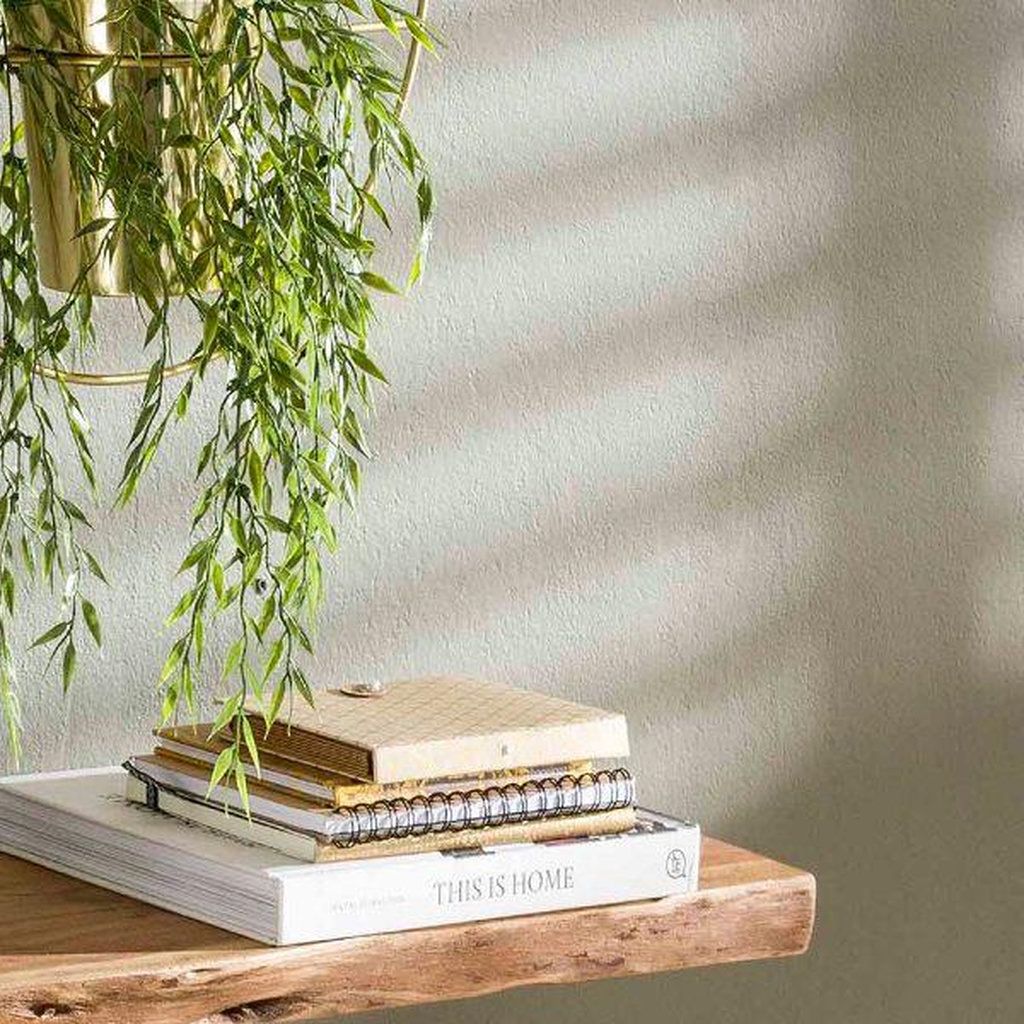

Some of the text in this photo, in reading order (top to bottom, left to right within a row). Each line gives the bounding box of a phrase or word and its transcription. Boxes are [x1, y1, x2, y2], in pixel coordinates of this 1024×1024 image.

[433, 877, 482, 905] THIS
[489, 874, 506, 898] IS
[512, 866, 575, 895] HOME
